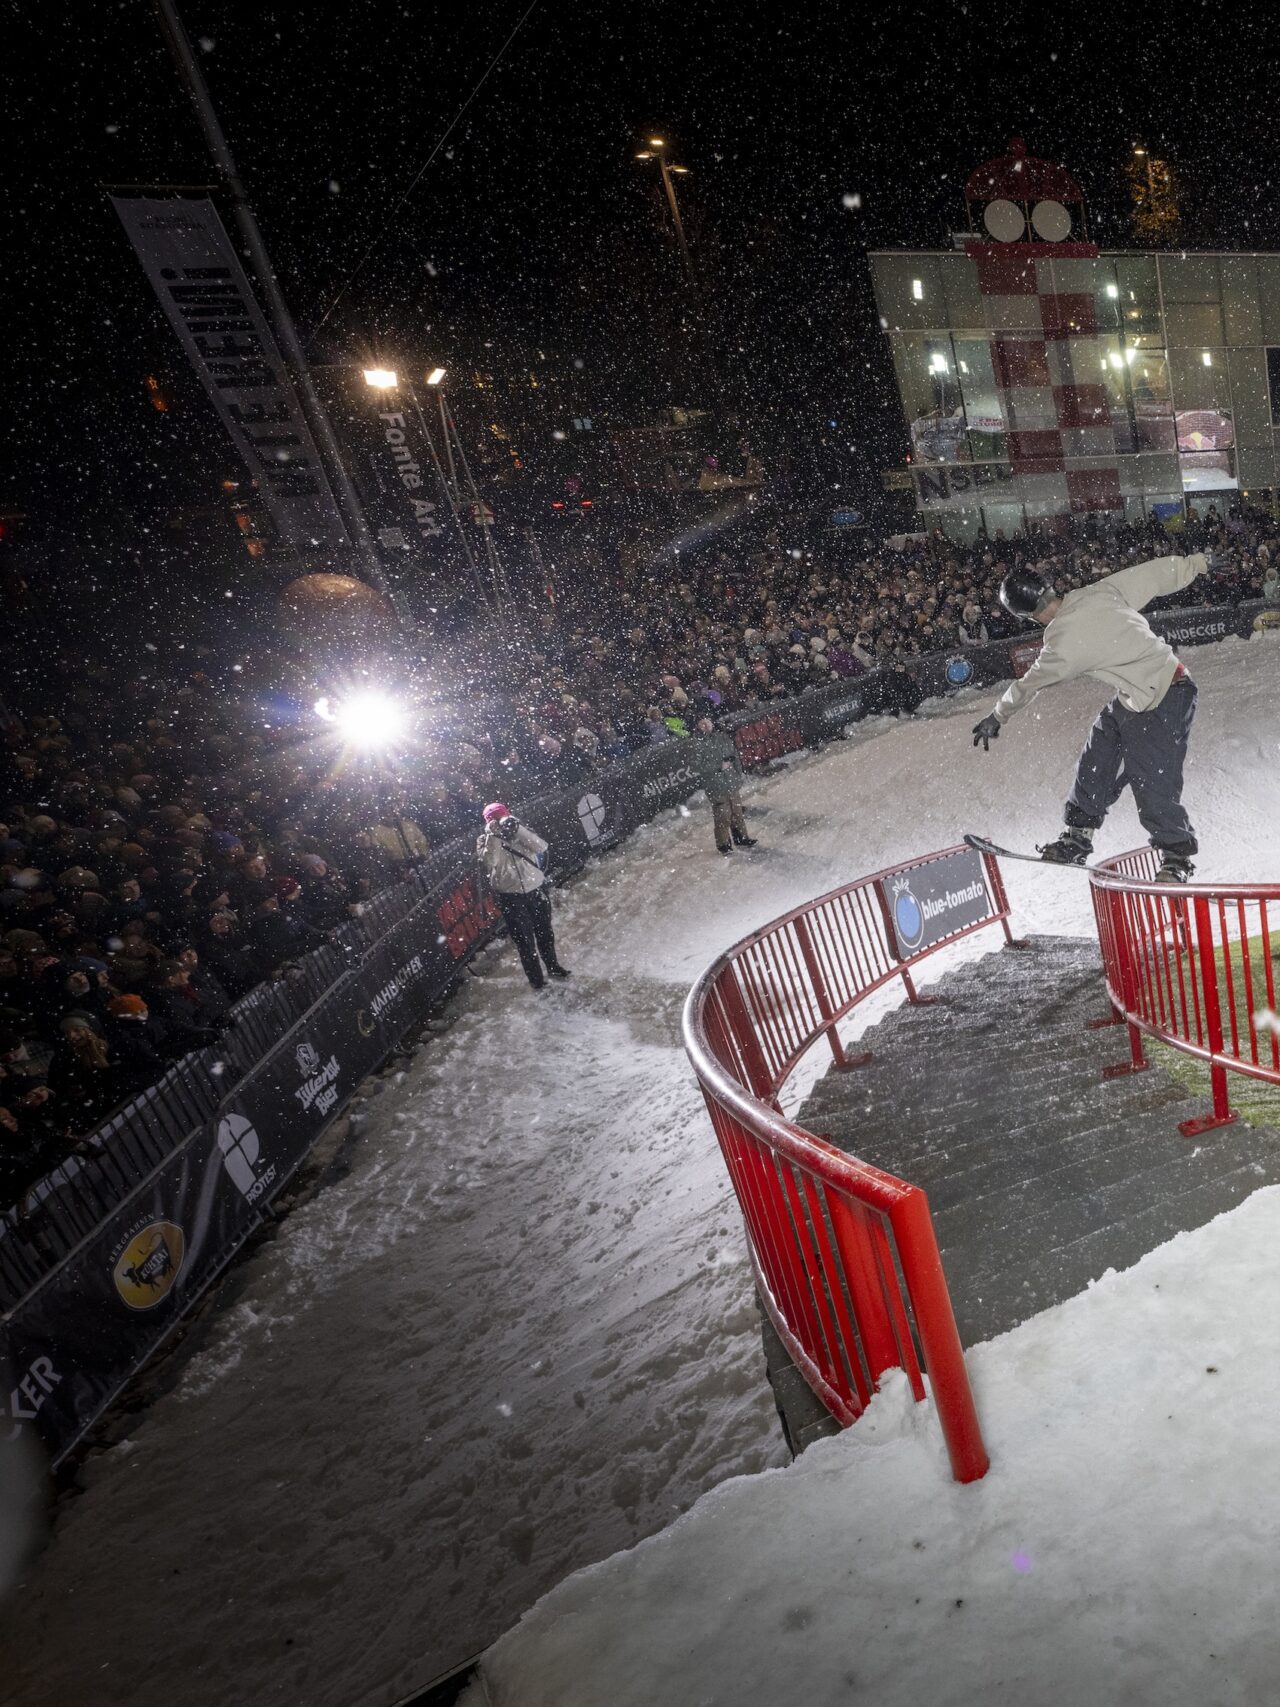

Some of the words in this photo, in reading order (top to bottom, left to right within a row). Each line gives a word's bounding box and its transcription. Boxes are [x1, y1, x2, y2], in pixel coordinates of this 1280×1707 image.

[379, 412, 422, 490] Fonte
[411, 497, 443, 538] Art
[1167, 622, 1226, 641] NIDECKER
[825, 700, 859, 719] WEBER
[642, 765, 701, 797] NIDECK
[921, 880, 984, 921] blue-tomato
[314, 1083, 339, 1117] Bier
[245, 1163, 277, 1206] PROTEST
[109, 1213, 155, 1264] BERGBAHNEN
